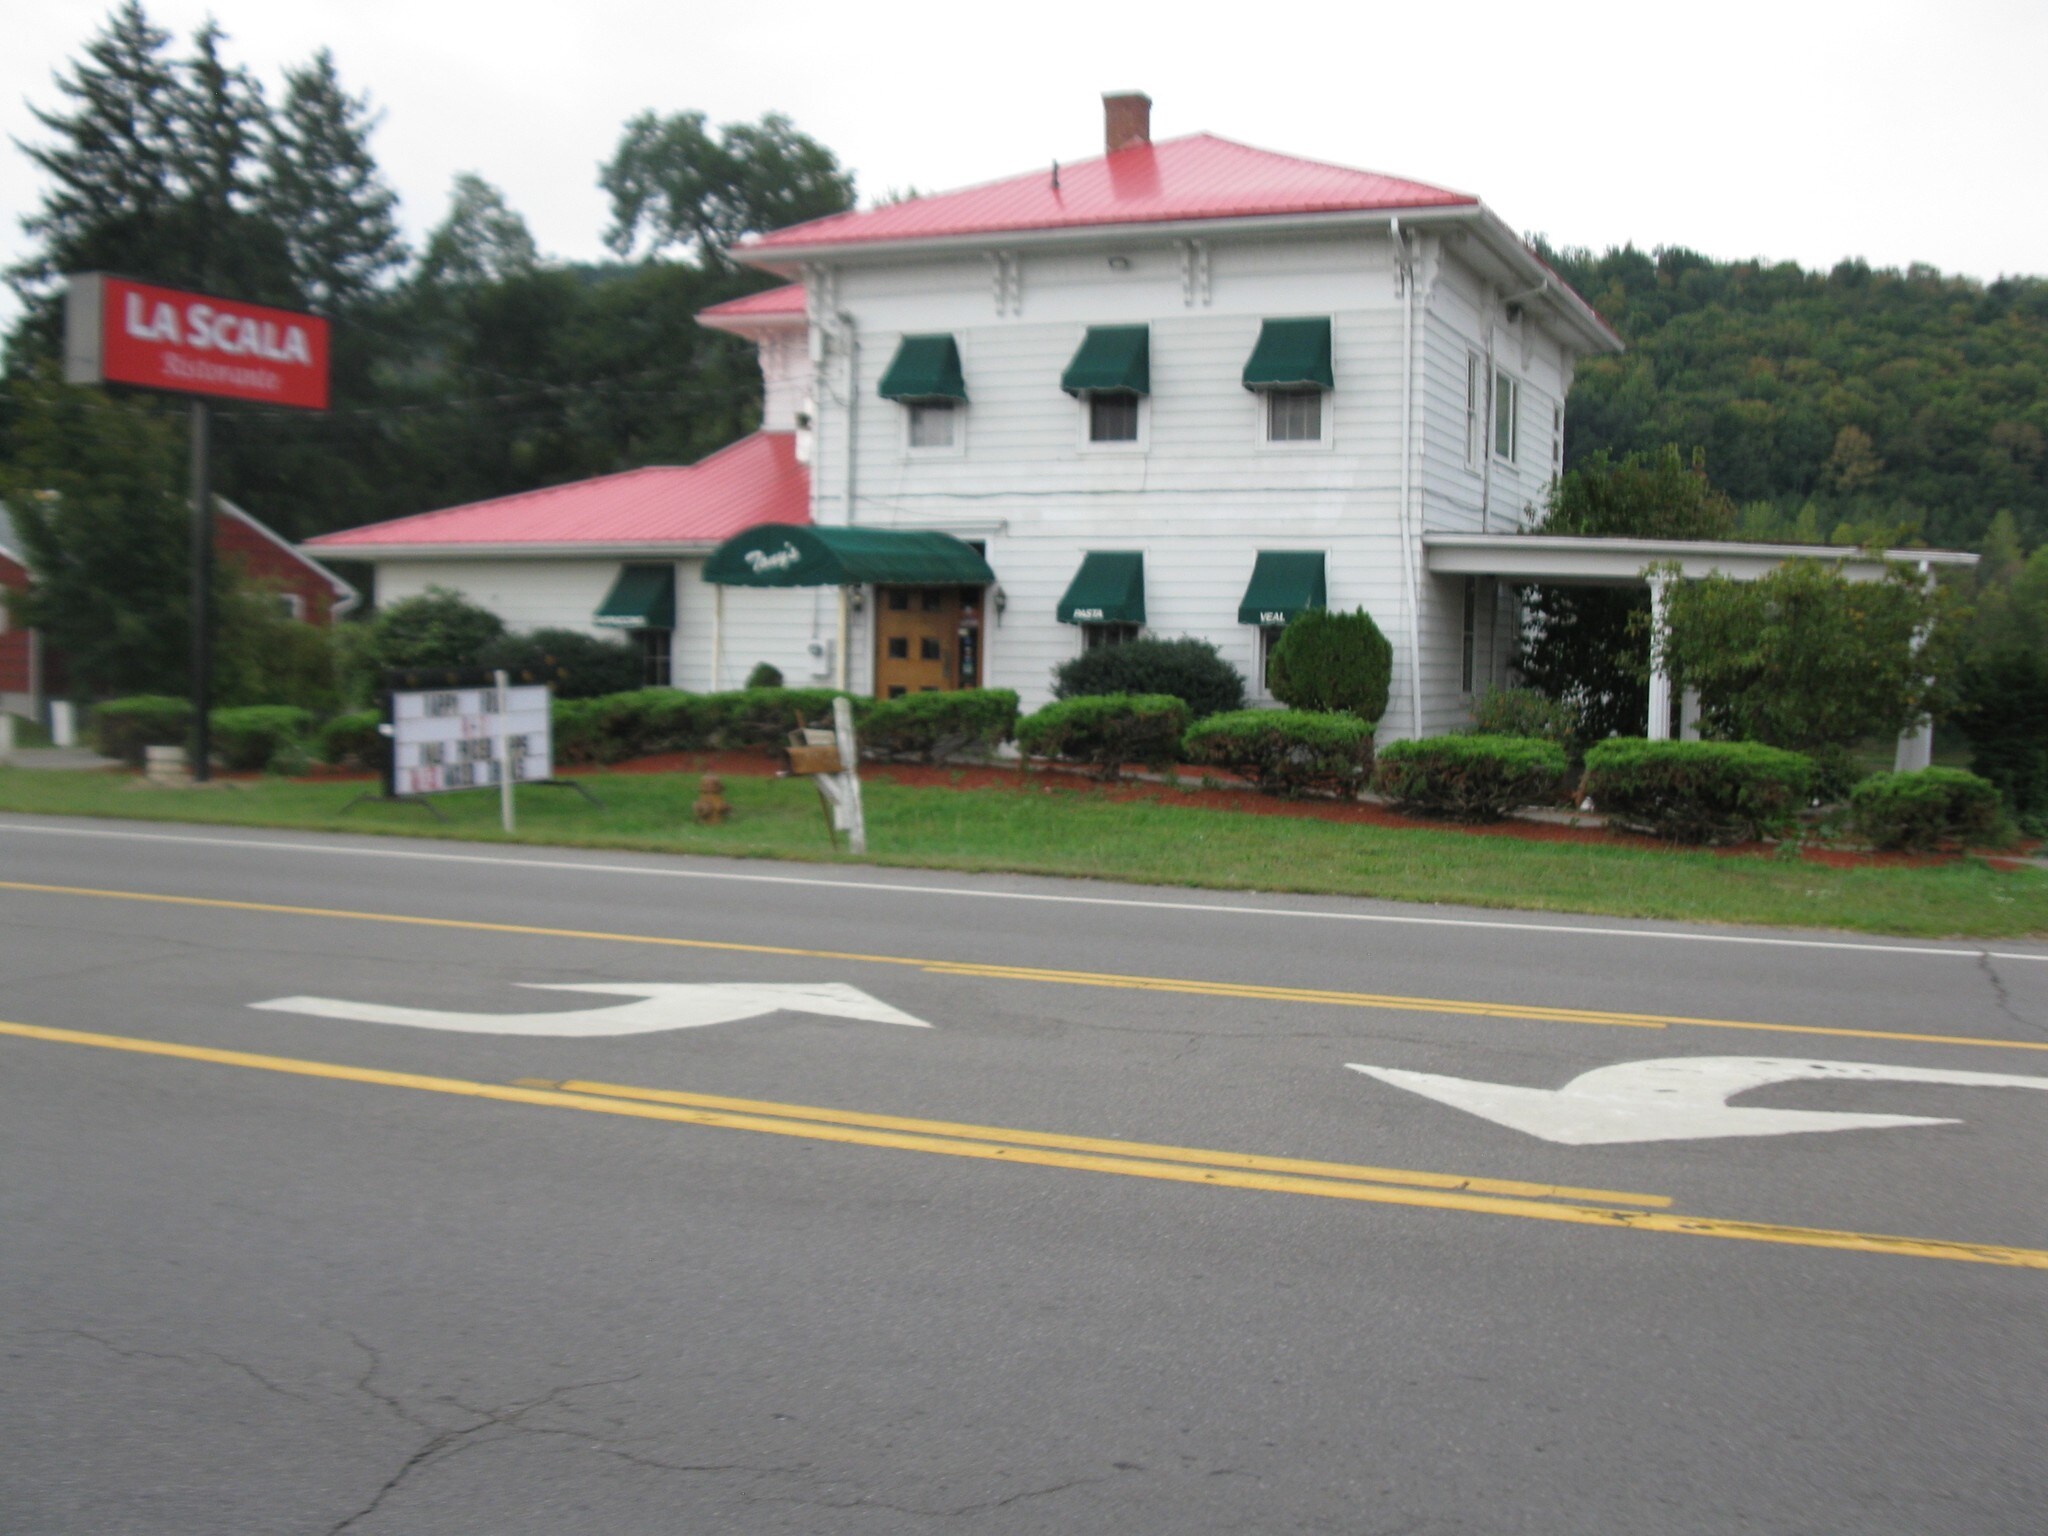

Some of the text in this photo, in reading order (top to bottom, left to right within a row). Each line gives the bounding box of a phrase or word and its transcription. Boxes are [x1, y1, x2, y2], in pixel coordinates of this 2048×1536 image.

[124, 291, 312, 366] LA SCALA
[1073, 608, 1104, 619] PASTA
[1260, 611, 1286, 623] VEAL
